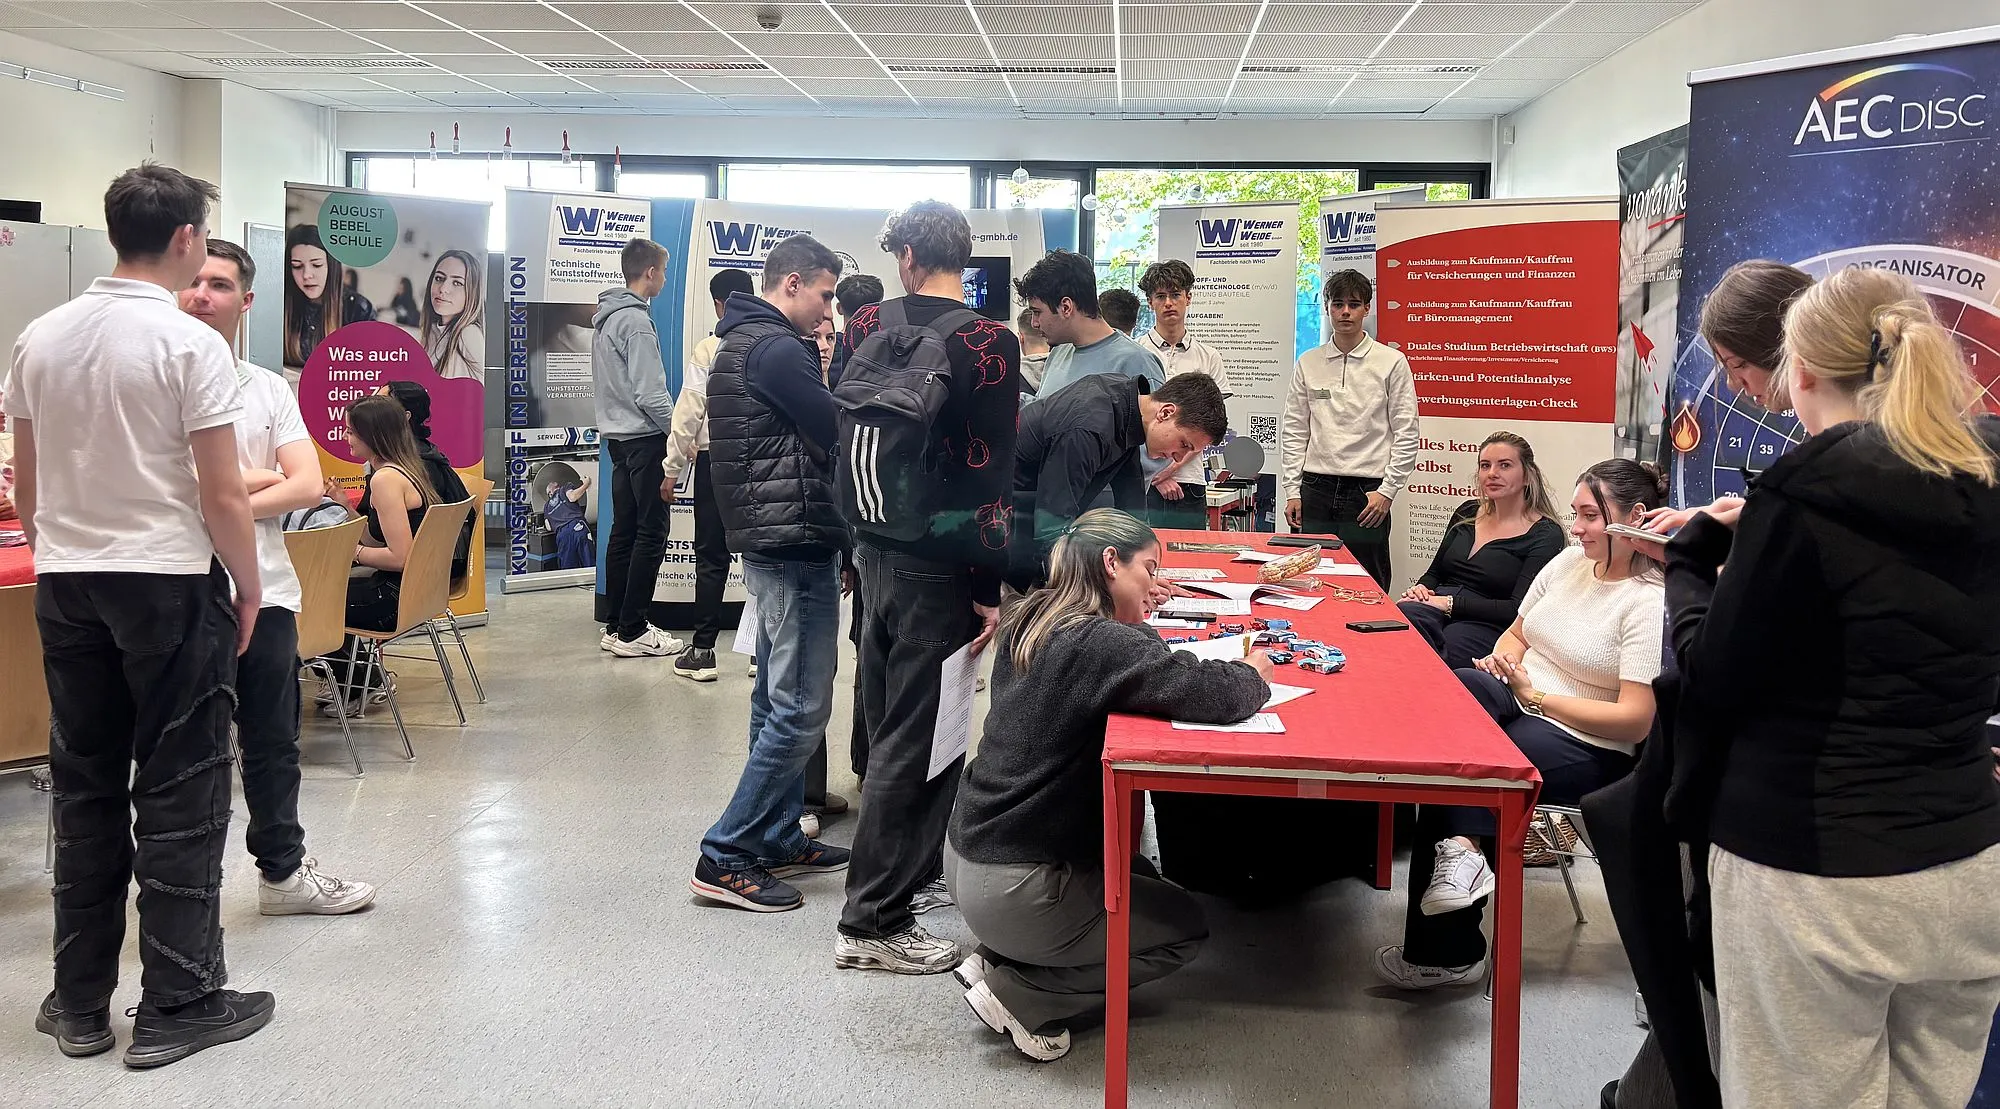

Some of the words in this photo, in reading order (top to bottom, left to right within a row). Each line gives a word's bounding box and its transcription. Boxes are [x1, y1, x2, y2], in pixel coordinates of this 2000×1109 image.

[1794, 94, 1895, 145] AEC
[1900, 94, 1987, 132] DISC
[1627, 162, 1686, 222] vorank
[330, 204, 384, 219] AUGUST
[607, 211, 645, 222] WERNER
[1357, 212, 1376, 222] WER
[330, 219, 371, 233] BEBEL
[604, 222, 635, 232] WEIDE
[1243, 220, 1284, 230] WERNER
[330, 234, 383, 248] SCHULE
[971, 233, 1019, 242] e-gmbh.de
[1240, 231, 1272, 241] WEIDE
[550, 260, 601, 269] Technische
[1469, 255, 1573, 265] Kaufmann/Kauffrau
[550, 269, 623, 279] Kunststoffwerks
[1407, 272, 1422, 280] für
[1424, 270, 1503, 281] Versicherungen
[1504, 270, 1525, 279] und
[1527, 270, 1576, 279] Finanzen
[1407, 301, 1450, 309] Ausbildung
[1469, 299, 1573, 308] Kaufmann/Kauffrau
[1407, 314, 1422, 322] für
[1424, 313, 1513, 324] Büromanagement
[510, 257, 528, 397] PERFEKTION
[1407, 342, 1442, 351] Duales
[1444, 342, 1488, 351] Studium
[1490, 342, 1589, 353] Betriebswirtschaft
[1590, 344, 1617, 353] (BWS)
[328, 347, 364, 361] Was
[368, 348, 409, 361] auch
[328, 366, 382, 381] immer
[1412, 372, 1475, 382] tärken-und
[1477, 373, 1572, 386] Potentialanalyse
[328, 386, 364, 401] dein
[1417, 394, 1578, 409] ewerbungsunterlagen-Check
[510, 401, 528, 425] IN
[1418, 438, 1445, 451] lles
[1729, 437, 1742, 448] 21
[1416, 460, 1452, 473] elbst
[511, 432, 528, 576] KUNSTSTOFF
[1429, 504, 1441, 512] Life
[1409, 511, 1451, 521] Partnergesell
[1409, 519, 1447, 528] Investment
[1409, 535, 1442, 544] Best-Sele
[1409, 544, 1439, 552] Preis-Lei
[657, 571, 684, 580] nische
